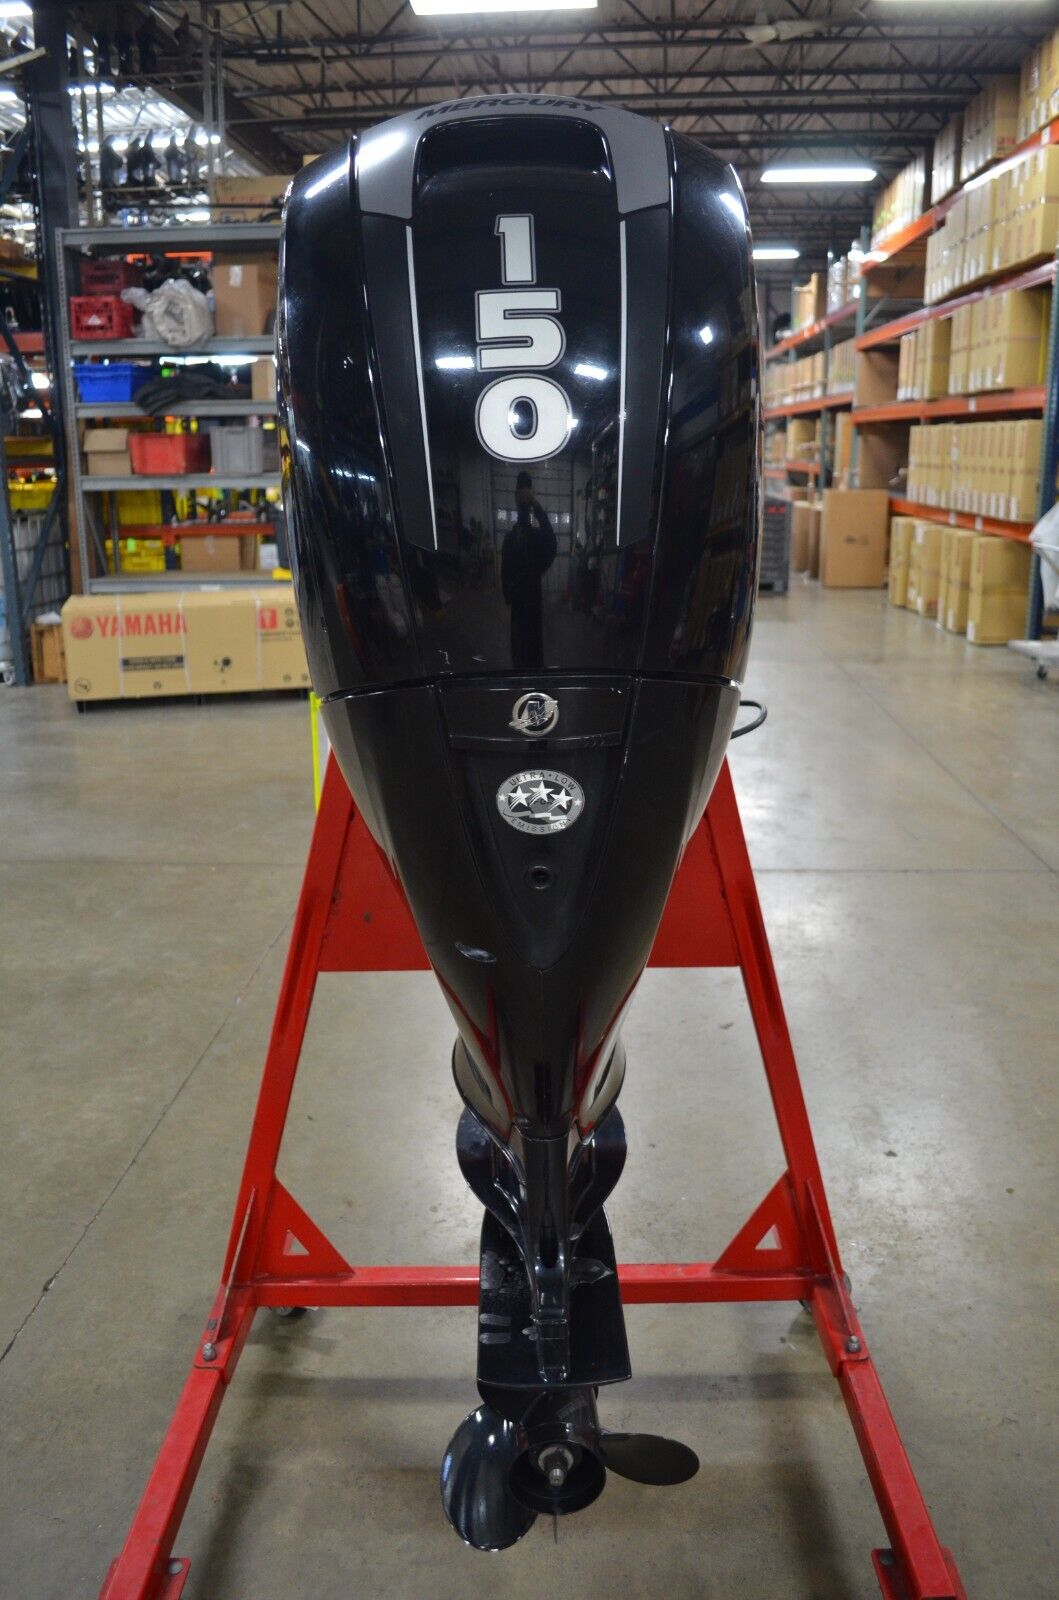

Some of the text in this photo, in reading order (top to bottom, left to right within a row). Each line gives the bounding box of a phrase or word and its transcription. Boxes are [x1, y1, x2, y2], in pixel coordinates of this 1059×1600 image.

[415, 97, 606, 120] MERCURY
[475, 213, 572, 463] 150
[96, 610, 187, 638] YAMAHA
[509, 771, 577, 791] ULTRA LOW
